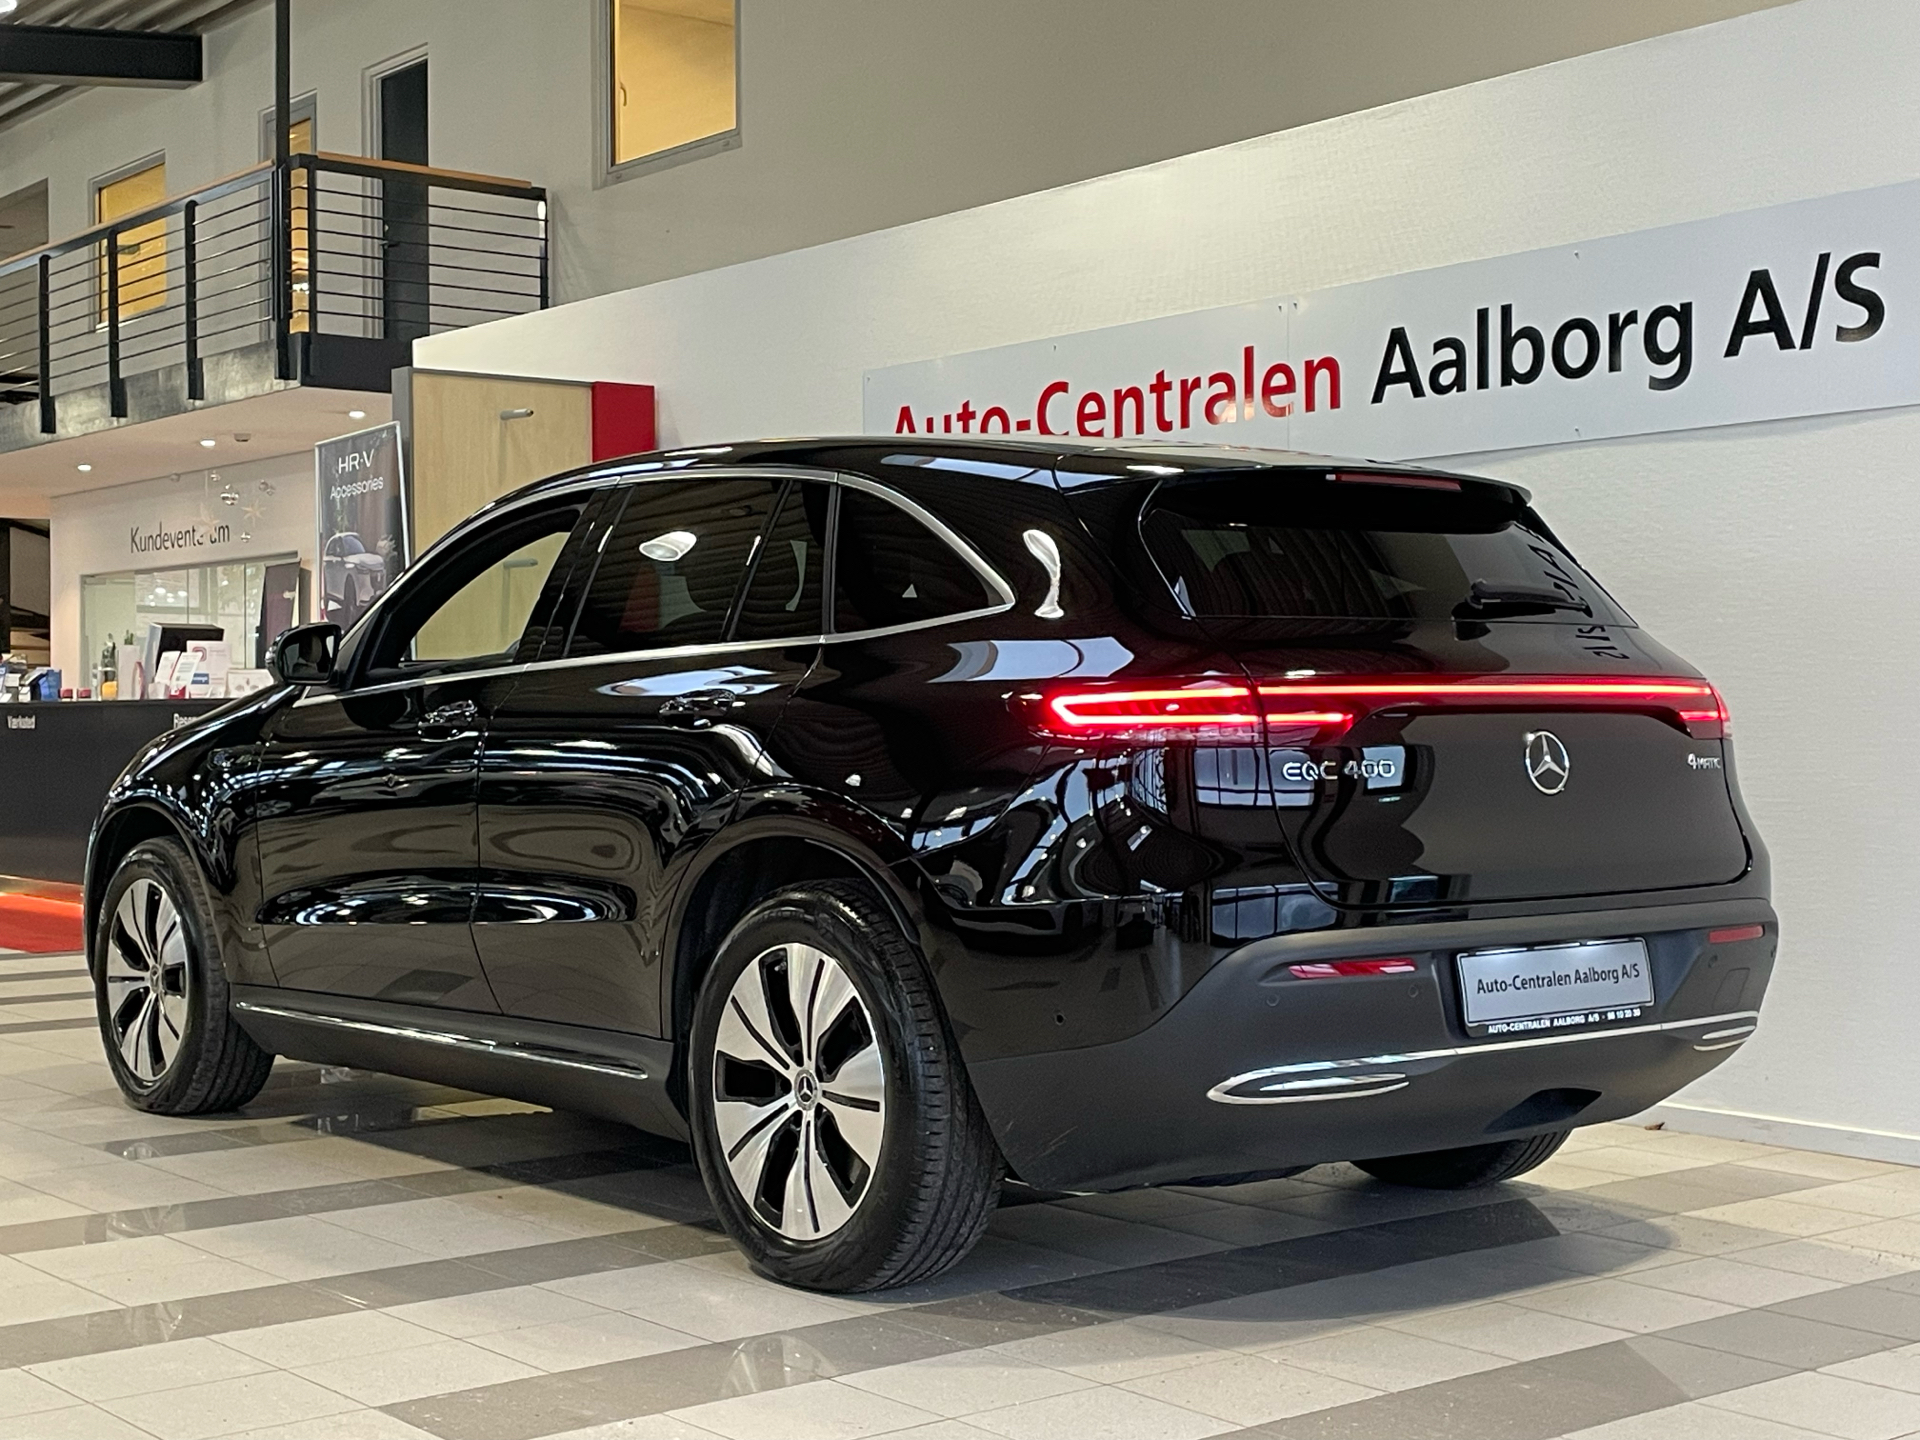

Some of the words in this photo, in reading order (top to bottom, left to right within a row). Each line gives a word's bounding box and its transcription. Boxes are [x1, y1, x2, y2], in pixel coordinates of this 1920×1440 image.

[1370, 301, 1693, 405] Aalborg
[1723, 252, 1886, 358] A/S
[330, 475, 384, 500] Accessories
[1282, 761, 1338, 781] EQC
[1344, 760, 1396, 779] 400
[1687, 753, 1721, 770] 4MATIC
[1477, 971, 1572, 994] Auto-Centralen
[1574, 966, 1619, 984] Aalborg
[1621, 963, 1640, 979] A/S
[1488, 1017, 1551, 1034] AUTO-CENTRALEN
[1553, 1014, 1586, 1027] AALBORG
